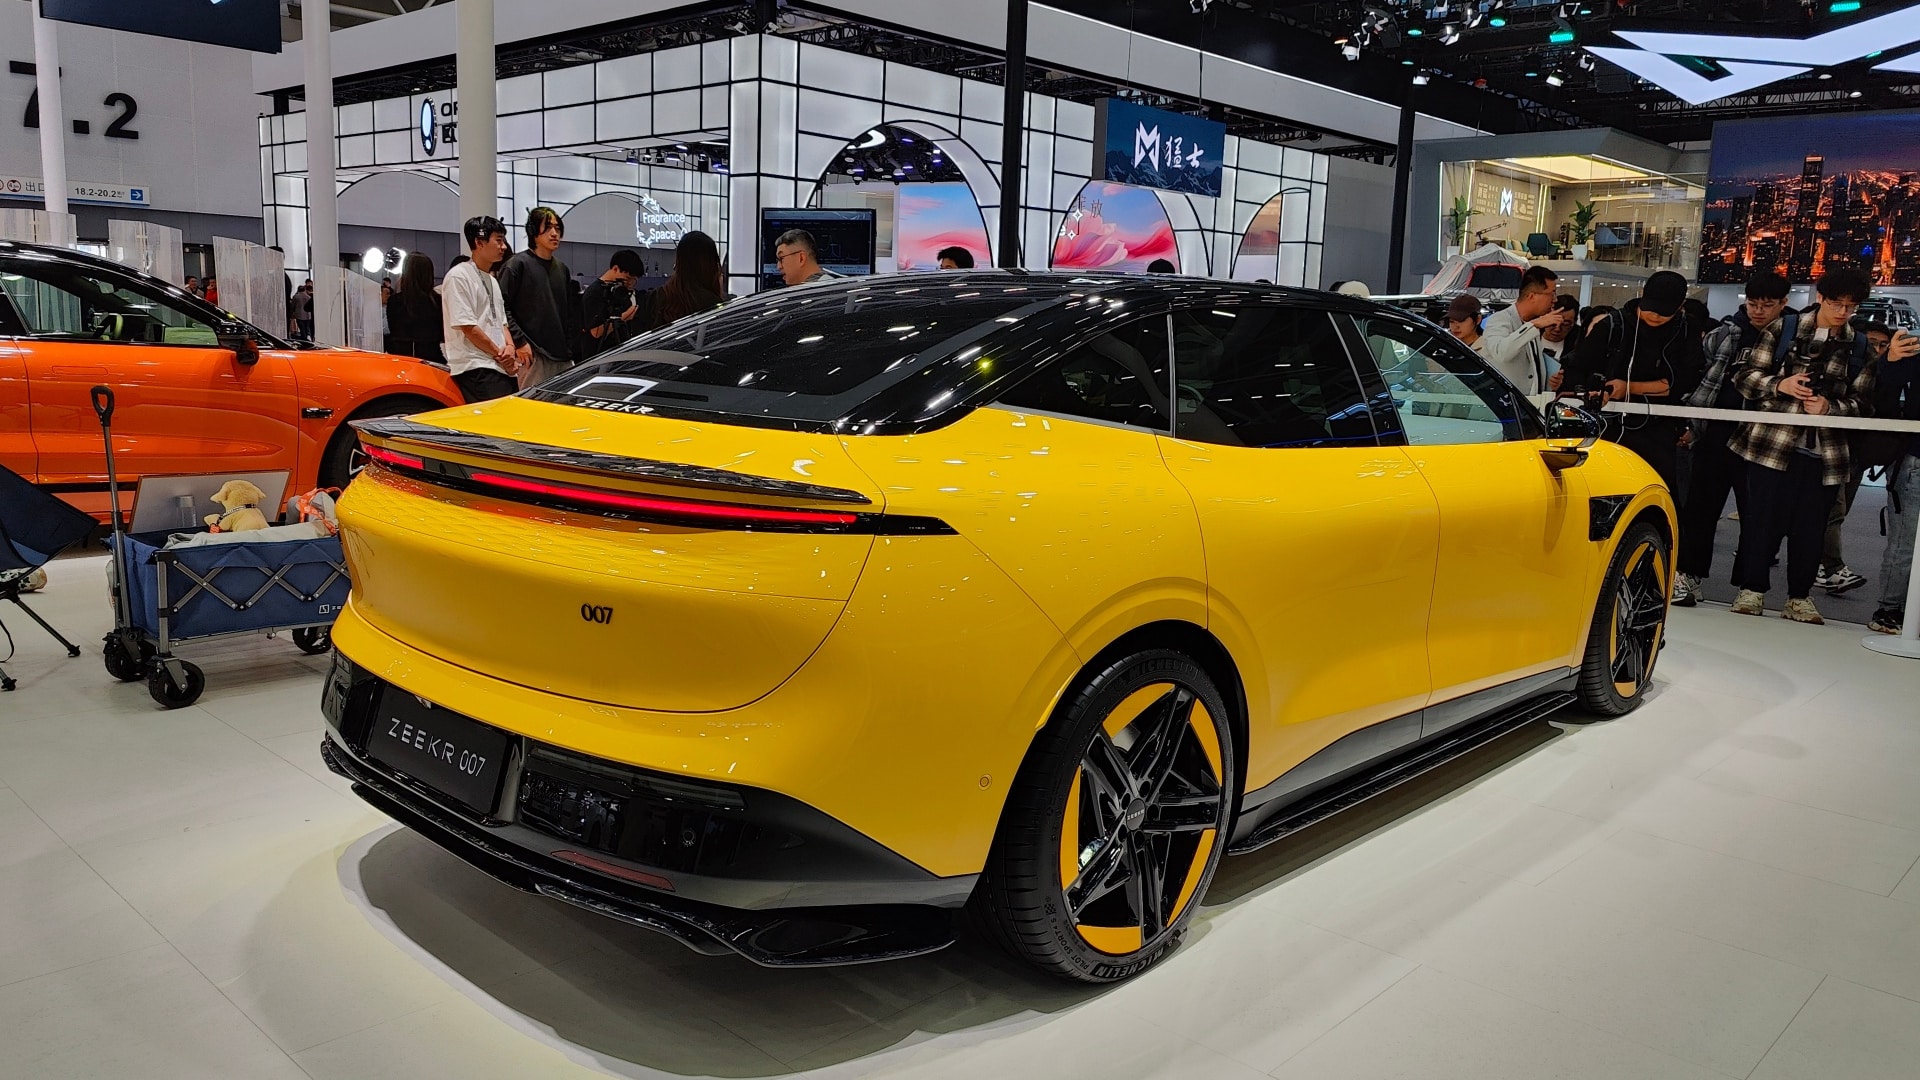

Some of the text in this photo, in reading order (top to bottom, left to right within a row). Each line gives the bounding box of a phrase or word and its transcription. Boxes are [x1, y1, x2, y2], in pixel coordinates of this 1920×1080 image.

[75, 187, 117, 198] 18.2-20.2
[642, 212, 686, 226] Fragrance
[650, 228, 677, 243] Space
[575, 399, 655, 415] ZEEKR
[580, 603, 614, 625] 007
[387, 717, 487, 777] ZEEKR 007
[1055, 930, 1073, 955] SPORT
[1071, 954, 1089, 970] PILOT
[1095, 947, 1164, 977] MICHELIN
